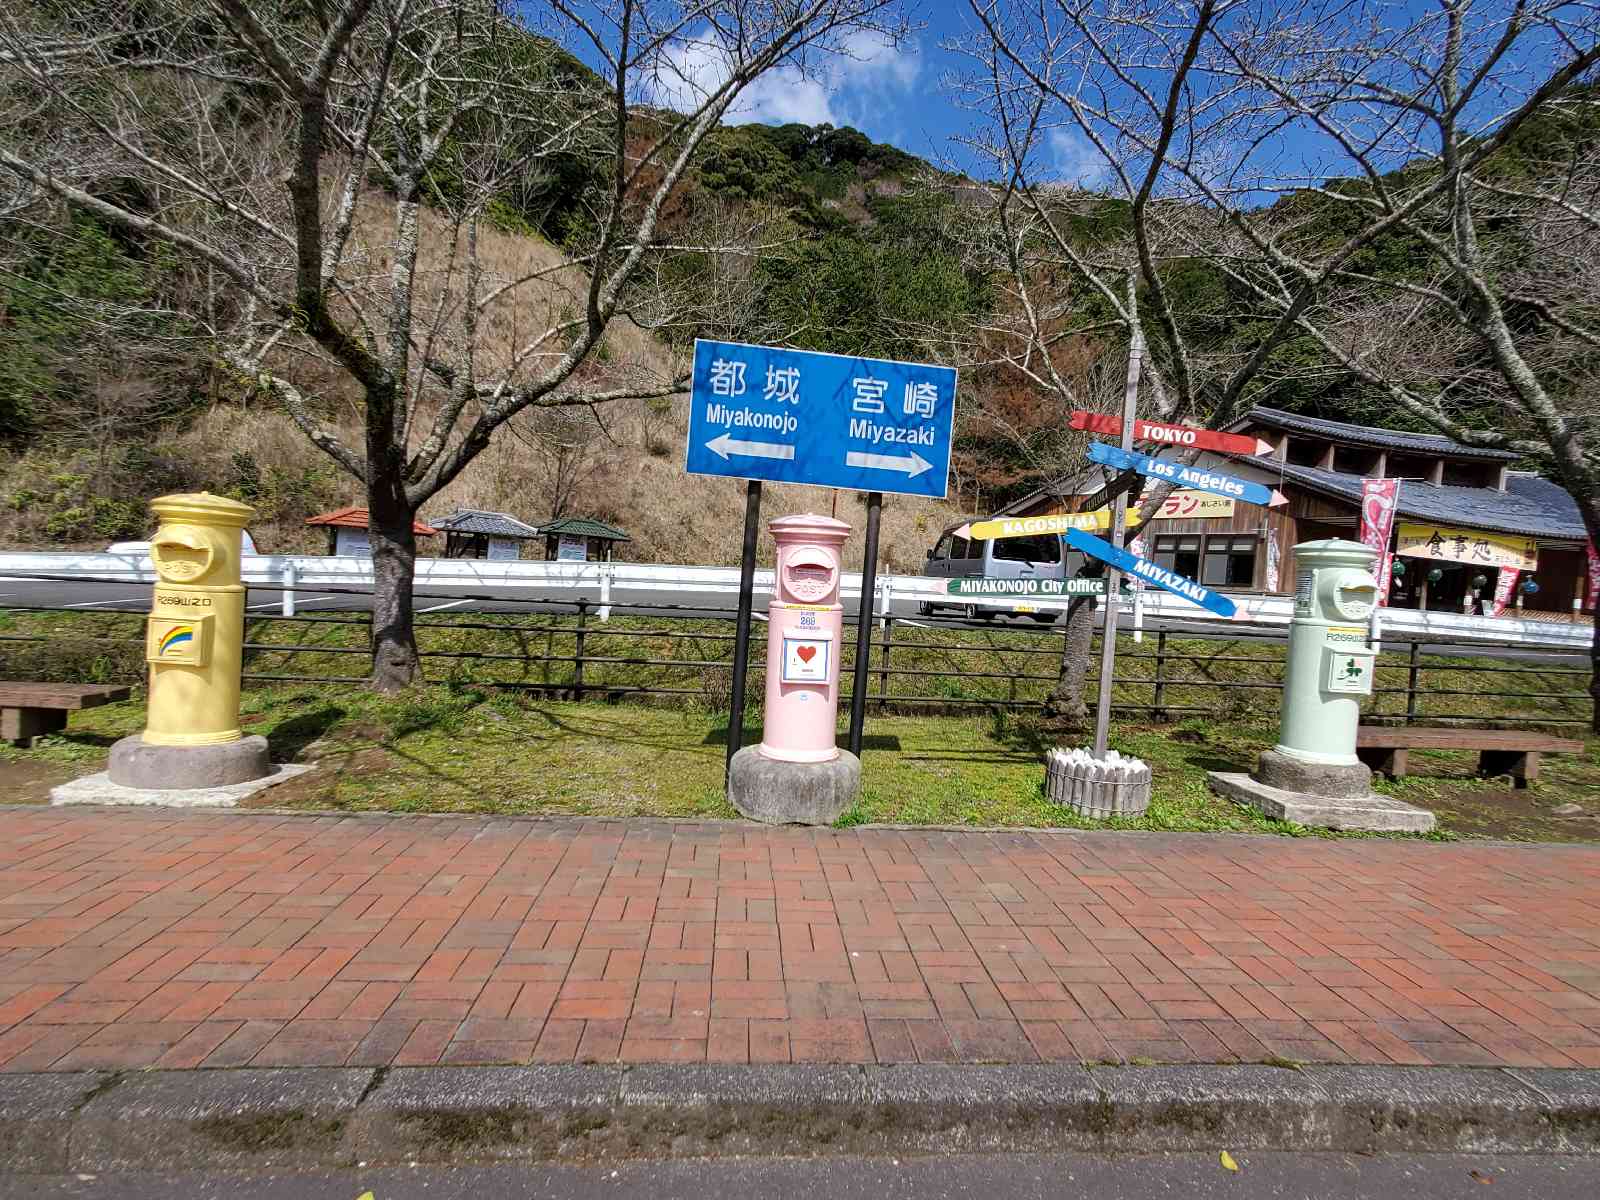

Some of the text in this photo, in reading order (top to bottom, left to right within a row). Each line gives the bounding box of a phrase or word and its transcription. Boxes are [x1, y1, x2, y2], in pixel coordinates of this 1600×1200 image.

[709, 357, 801, 405] 都城
[852, 376, 938, 420] 宮崎
[706, 403, 798, 435] Miyakonojo
[849, 418, 936, 446] Miyazaki
[1142, 425, 1196, 444] TOKYO
[1147, 459, 1244, 496] Los Angeles
[1002, 515, 1098, 535] KAGOSHIMA
[1425, 530, 1492, 562] 食事処
[960, 579, 1038, 594] MIYAKONOJO
[1041, 579, 1065, 595] City
[1067, 579, 1104, 593] Office
[1132, 559, 1208, 602] MIYAZAKI
